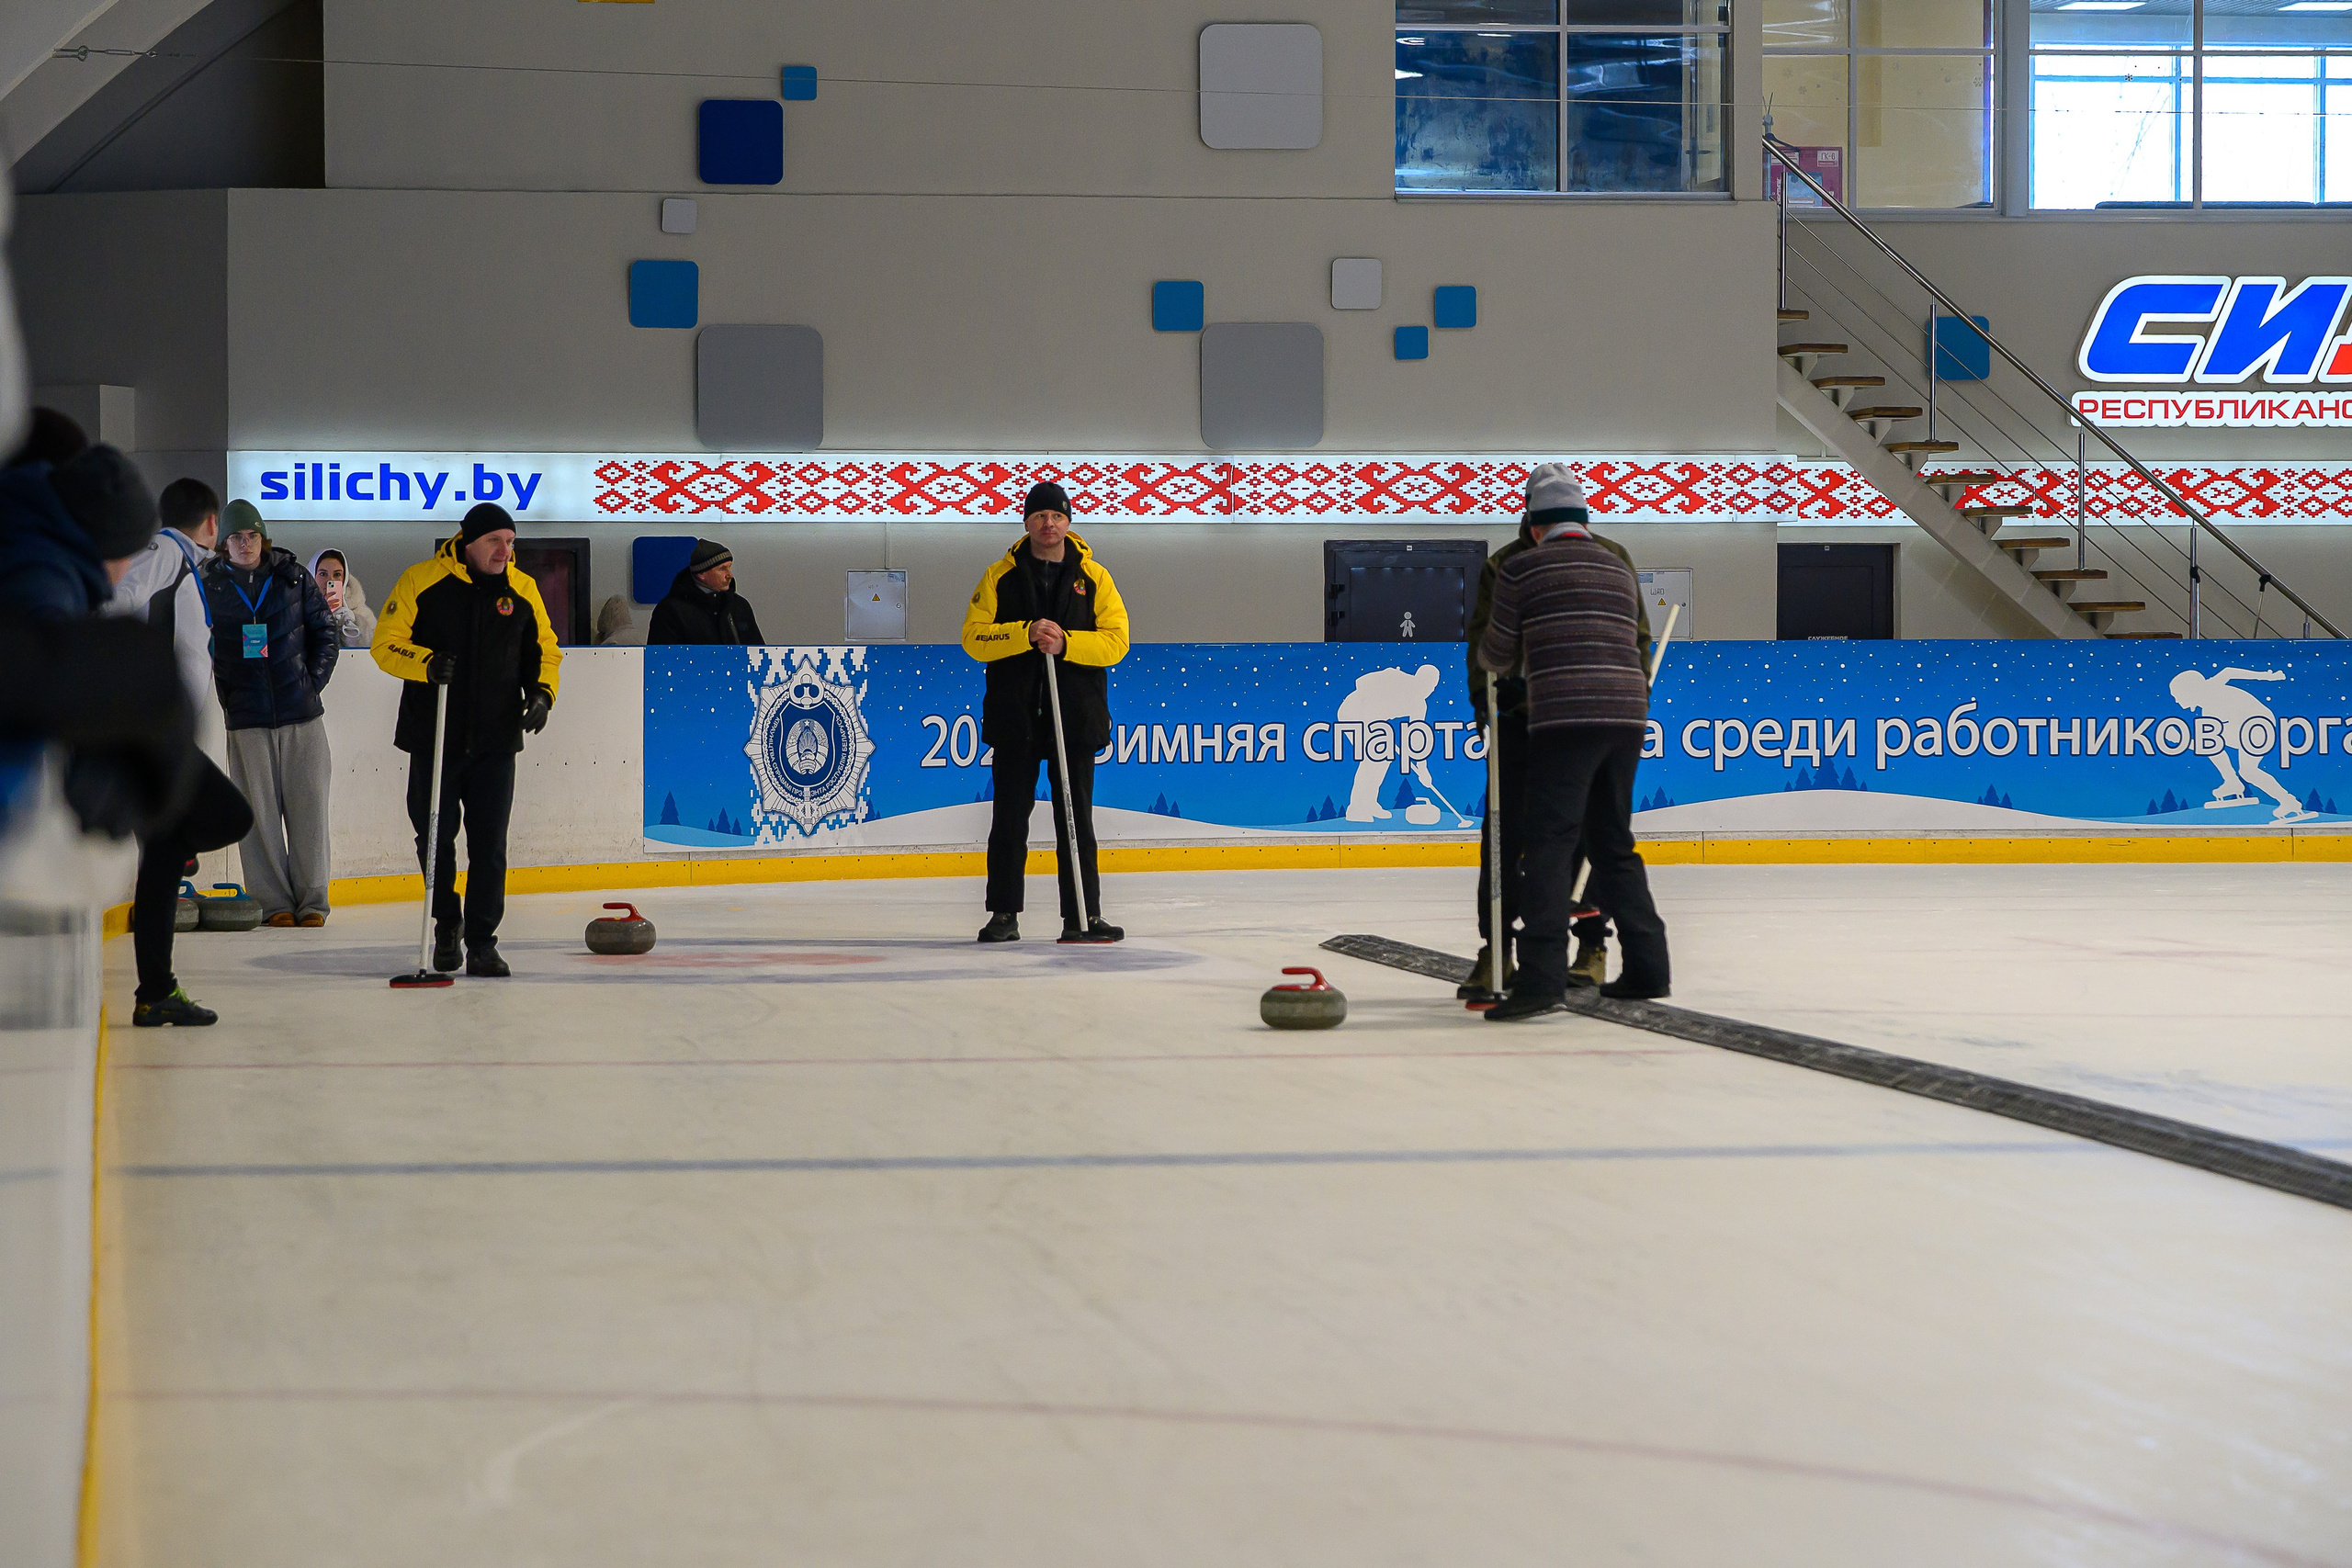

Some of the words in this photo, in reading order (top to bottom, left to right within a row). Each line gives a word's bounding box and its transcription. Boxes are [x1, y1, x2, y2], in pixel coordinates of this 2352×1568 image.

[260, 462, 543, 510] silichy.by
[921, 715, 993, 768] 20
[1681, 717, 1857, 771] среди
[1875, 701, 2225, 770] работников
